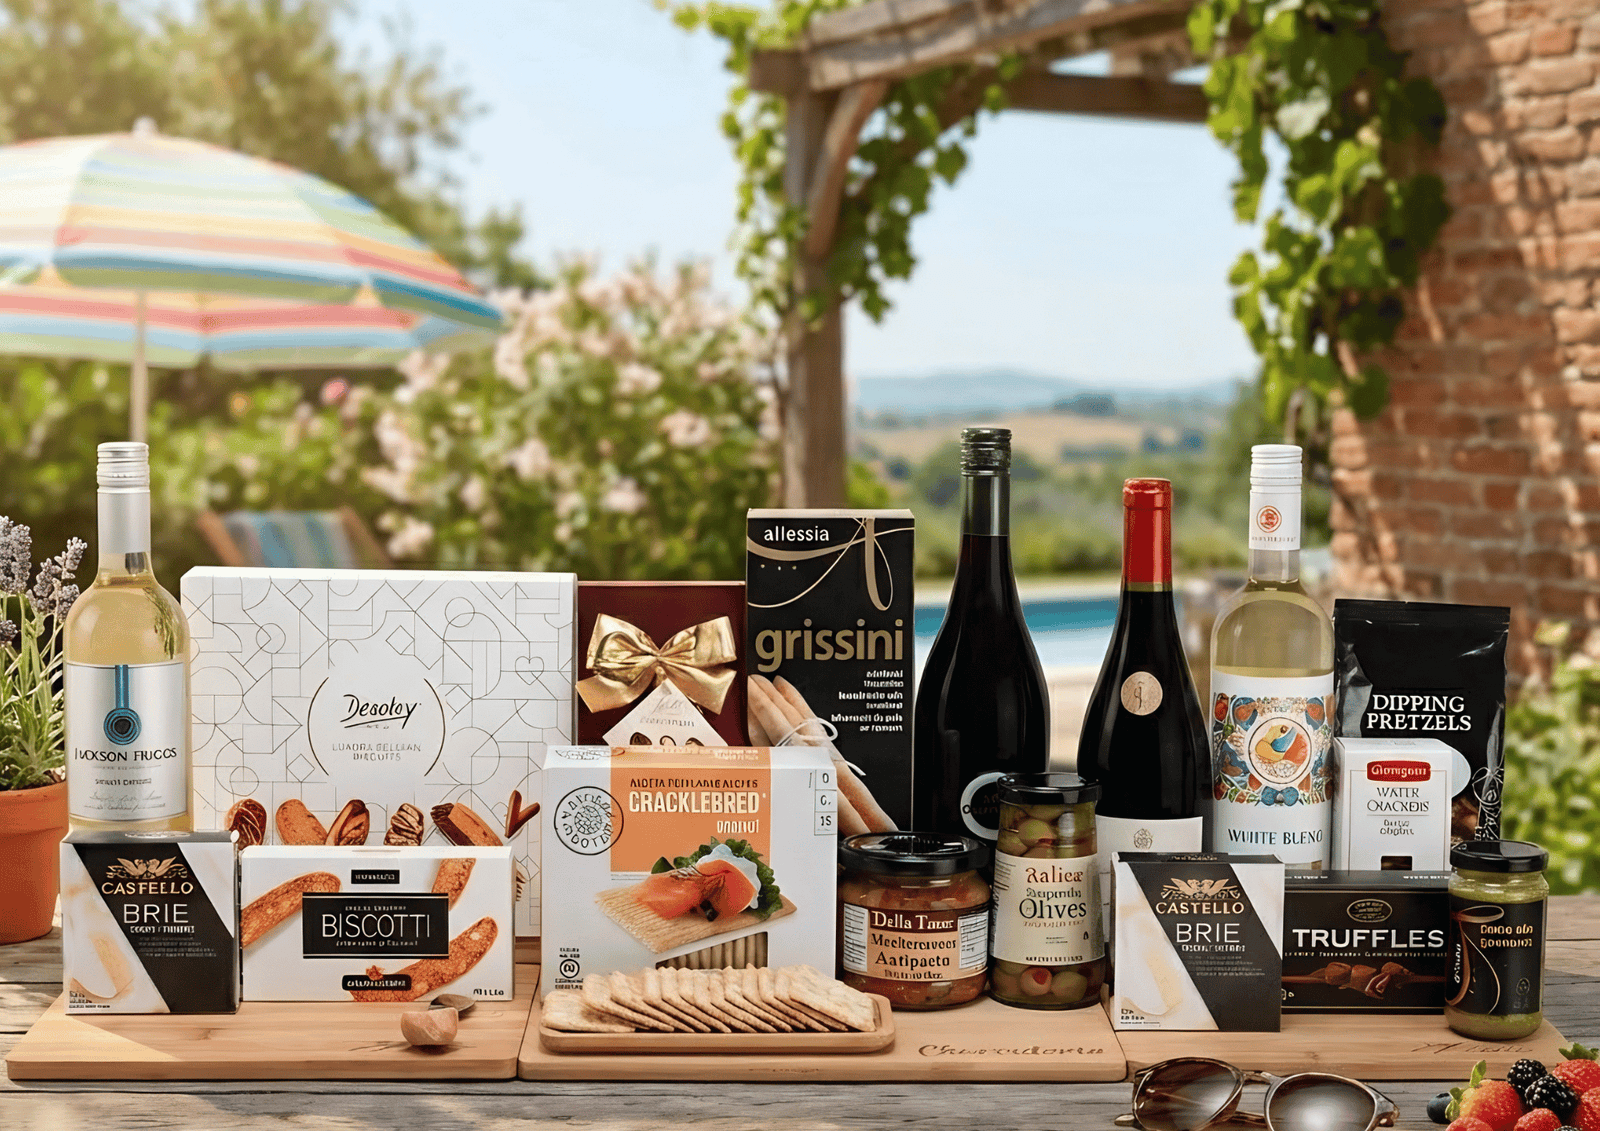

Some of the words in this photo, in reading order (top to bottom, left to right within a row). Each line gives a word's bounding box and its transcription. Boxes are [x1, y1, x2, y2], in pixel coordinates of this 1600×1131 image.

[763, 525, 830, 542] allessia
[755, 618, 904, 673] grissini
[1372, 694, 1465, 713] DIPPING
[1366, 713, 1472, 732] PRETZELS
[629, 790, 760, 814] CRACKLEBRED
[123, 903, 190, 924] BRIE
[1155, 902, 1245, 914] CASTELLO
[321, 912, 431, 938] BISCOTTI
[1176, 923, 1240, 943] BRIE
[1292, 928, 1445, 949] TRUFFLES
